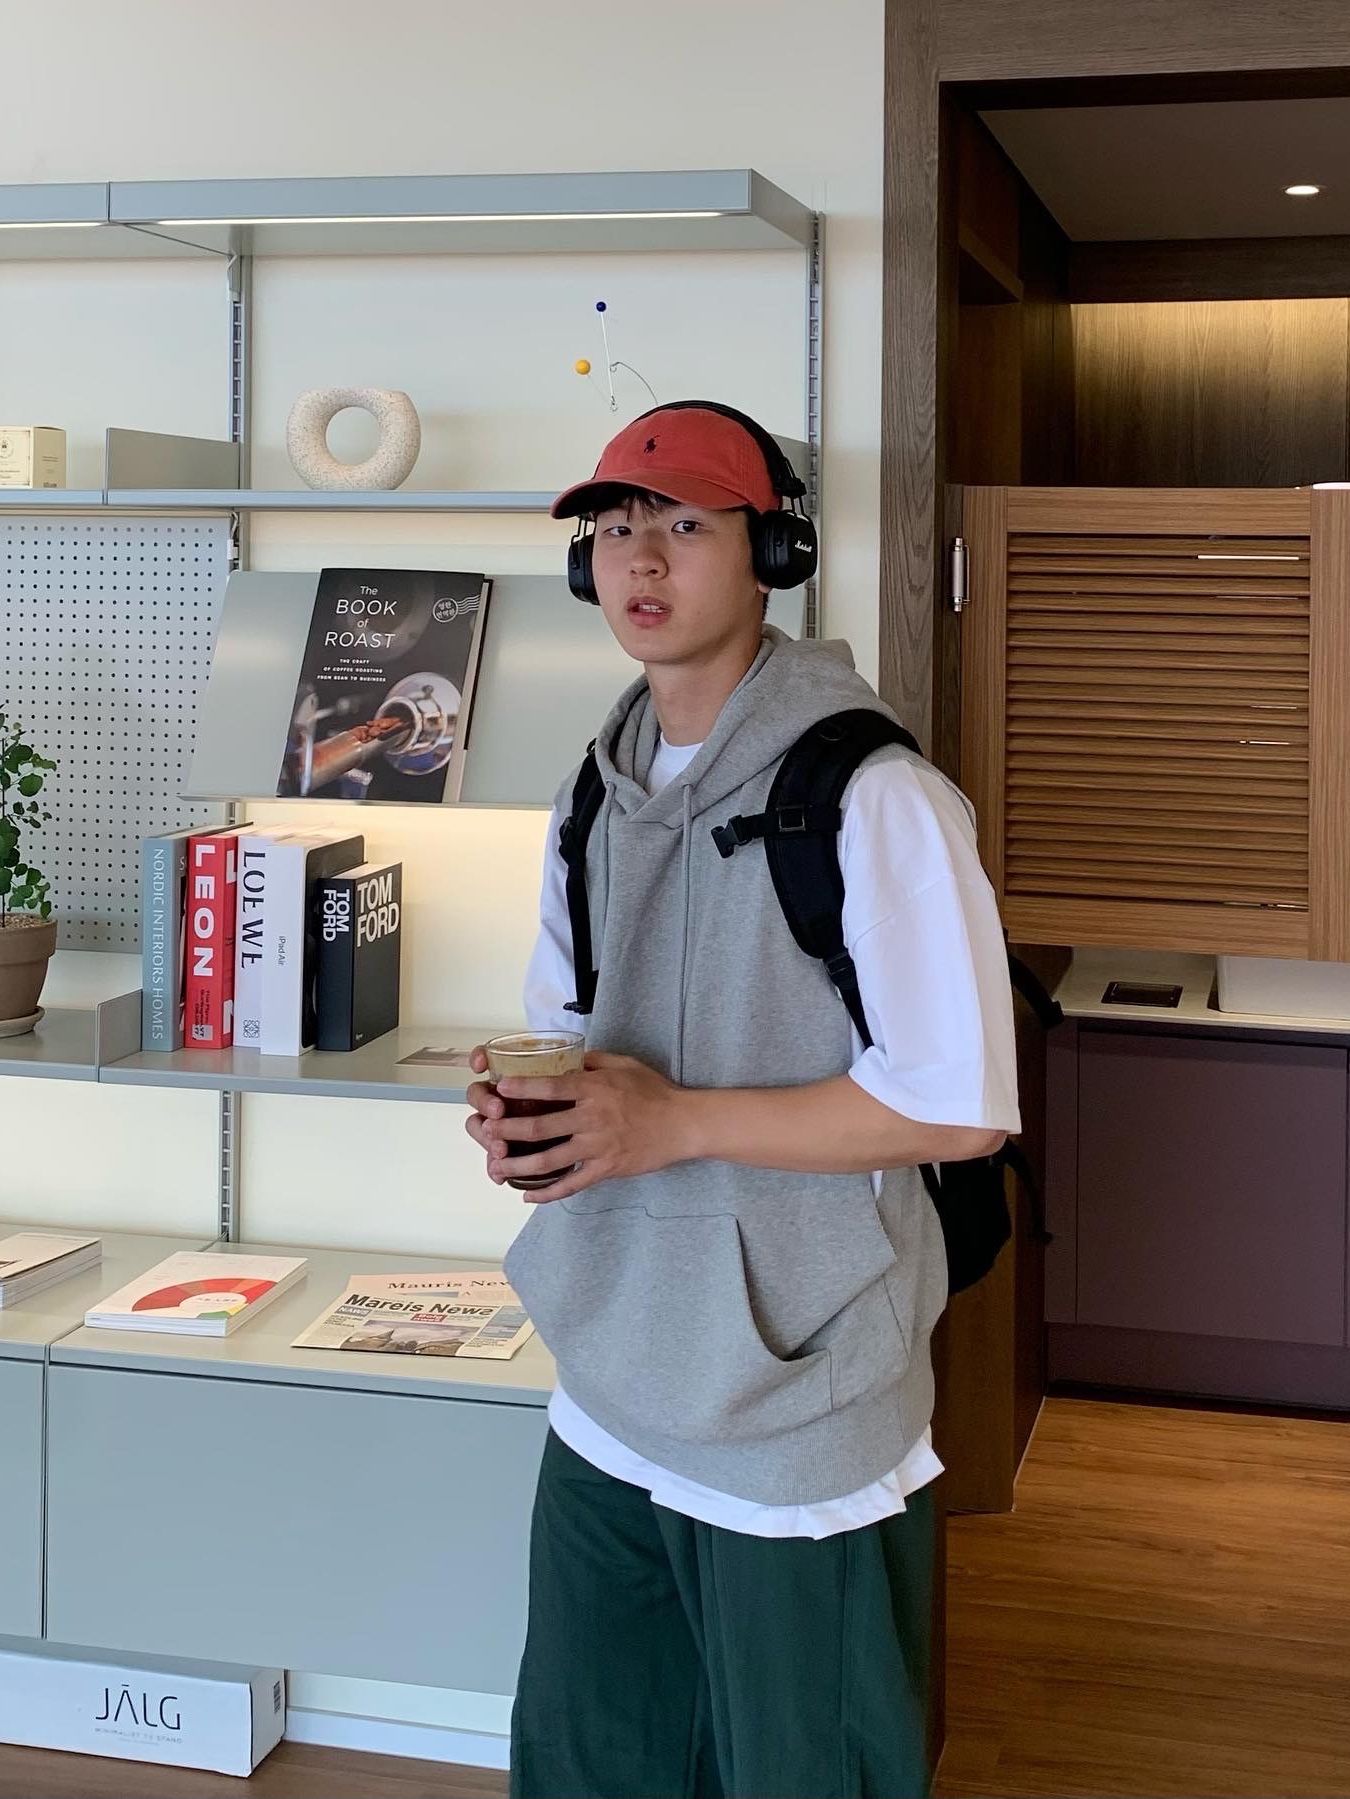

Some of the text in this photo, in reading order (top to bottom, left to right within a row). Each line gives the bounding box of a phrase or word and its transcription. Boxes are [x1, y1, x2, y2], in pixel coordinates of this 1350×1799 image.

[336, 600, 397, 615] BOOK
[360, 586, 378, 595] The
[324, 632, 396, 648] ROAST
[357, 618, 370, 628] of
[193, 844, 216, 977] LEON
[241, 851, 266, 970] LOEWE
[336, 888, 350, 932] TOM
[357, 872, 393, 914] TOM
[323, 889, 337, 942] FORD
[357, 902, 400, 947] FORD
[152, 848, 165, 1040] NORDIC INTERIORS HOMES
[278, 935, 287, 966] iPad Air
[344, 1294, 424, 1312] Mareis
[387, 1281, 462, 1289] Mauris
